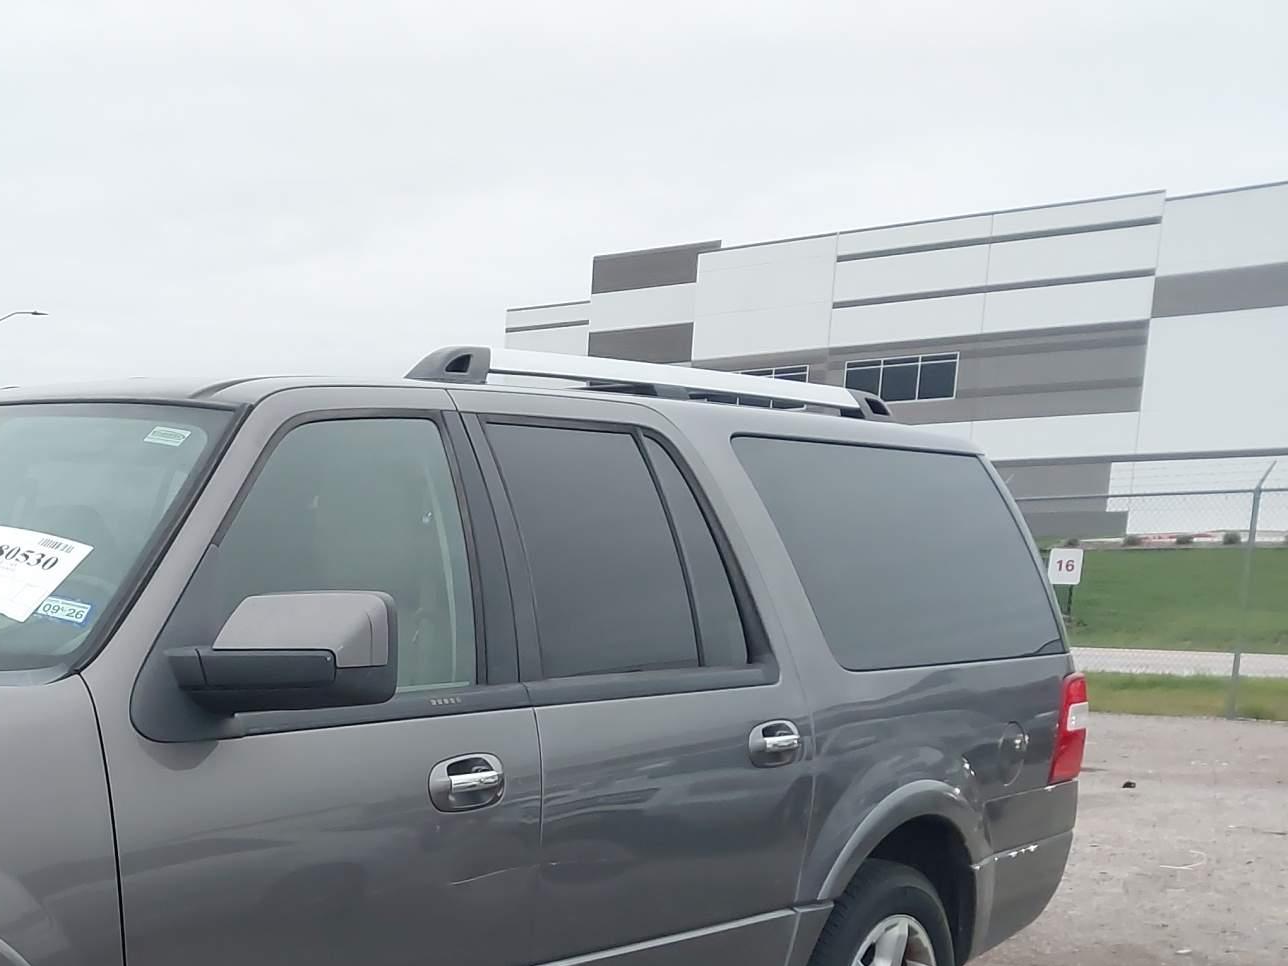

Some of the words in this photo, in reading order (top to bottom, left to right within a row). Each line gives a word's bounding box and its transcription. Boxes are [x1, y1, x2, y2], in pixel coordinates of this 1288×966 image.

[1056, 559, 1075, 572] 16
[42, 603, 60, 614] 09
[65, 608, 85, 620] 26
